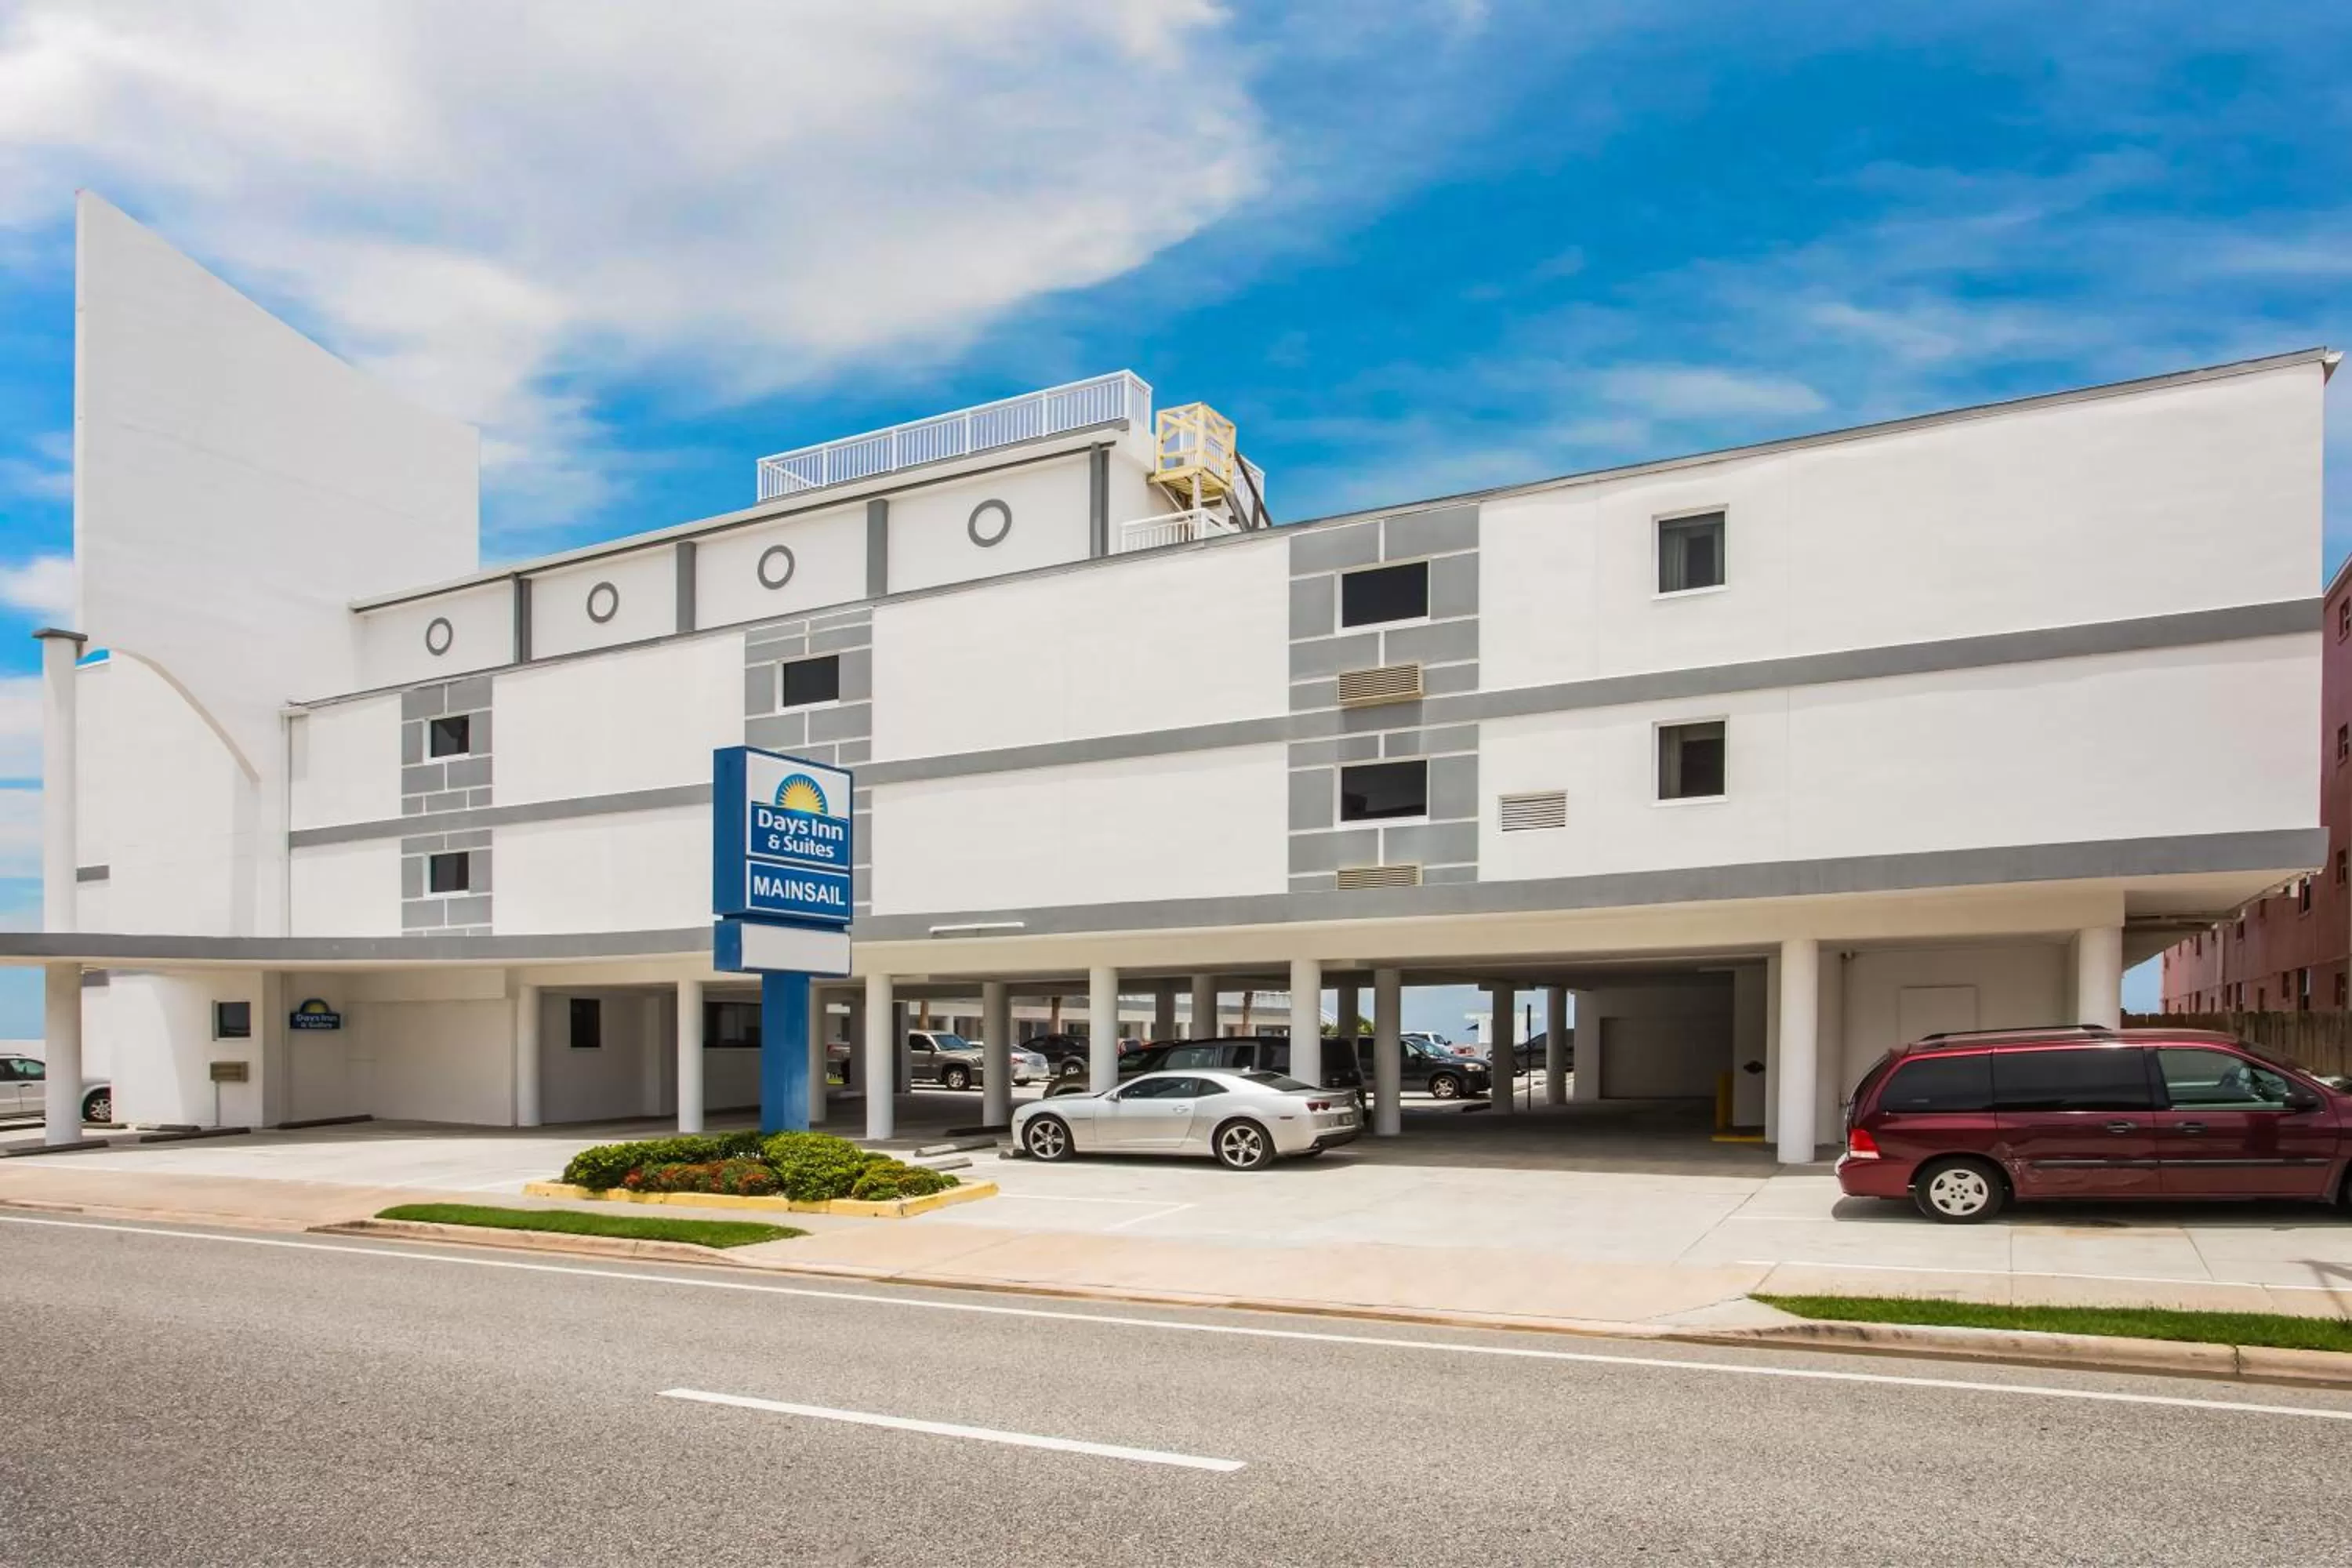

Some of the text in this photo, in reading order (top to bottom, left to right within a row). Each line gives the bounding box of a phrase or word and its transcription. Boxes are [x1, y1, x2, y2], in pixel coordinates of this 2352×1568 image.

[757, 808, 844, 841] Days Inn
[768, 834, 835, 858] & Suites
[753, 876, 846, 906] MAINSAIL
